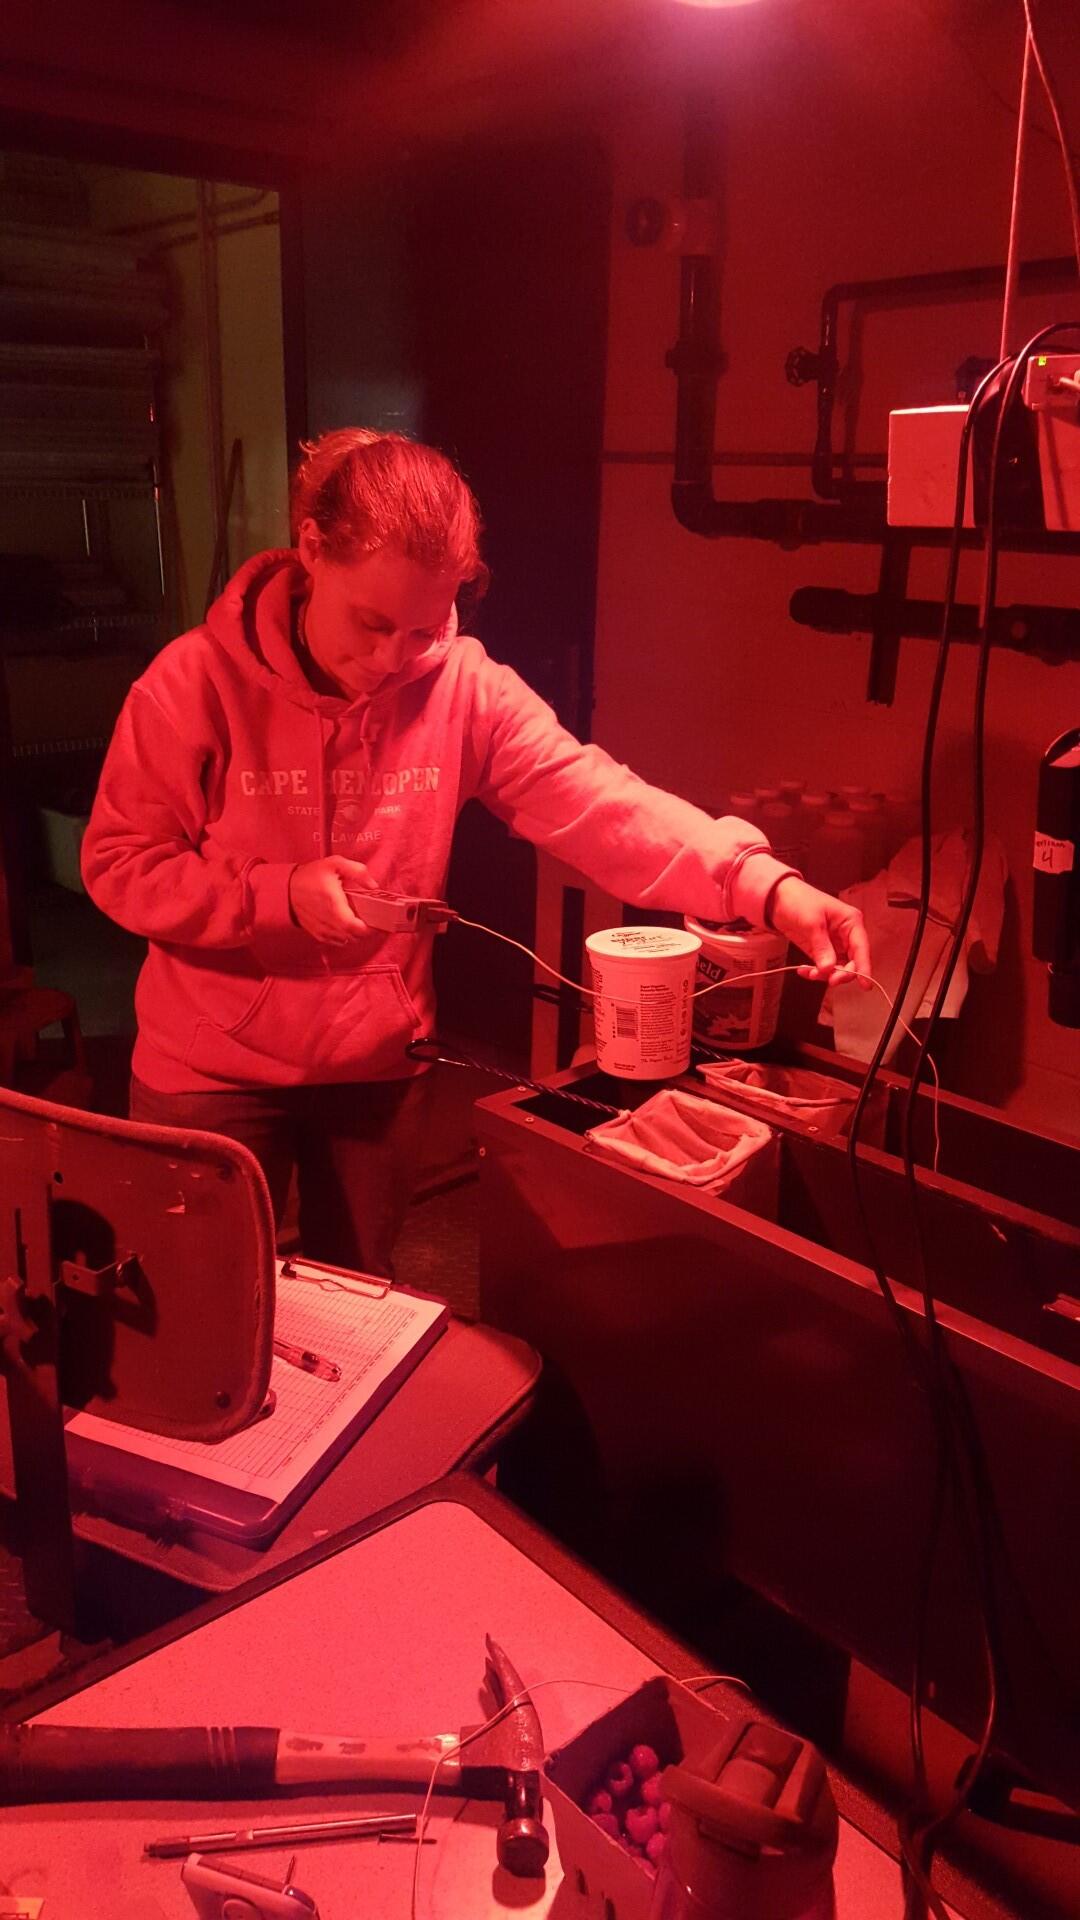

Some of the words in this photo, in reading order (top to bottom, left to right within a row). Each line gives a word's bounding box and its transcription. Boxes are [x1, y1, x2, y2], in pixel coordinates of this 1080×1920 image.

[240, 769, 308, 796] CAPE
[287, 806, 322, 816] STATE
[374, 805, 401, 817] PARK
[312, 830, 382, 843] DLAWARE
[1042, 848, 1053, 868] 4
